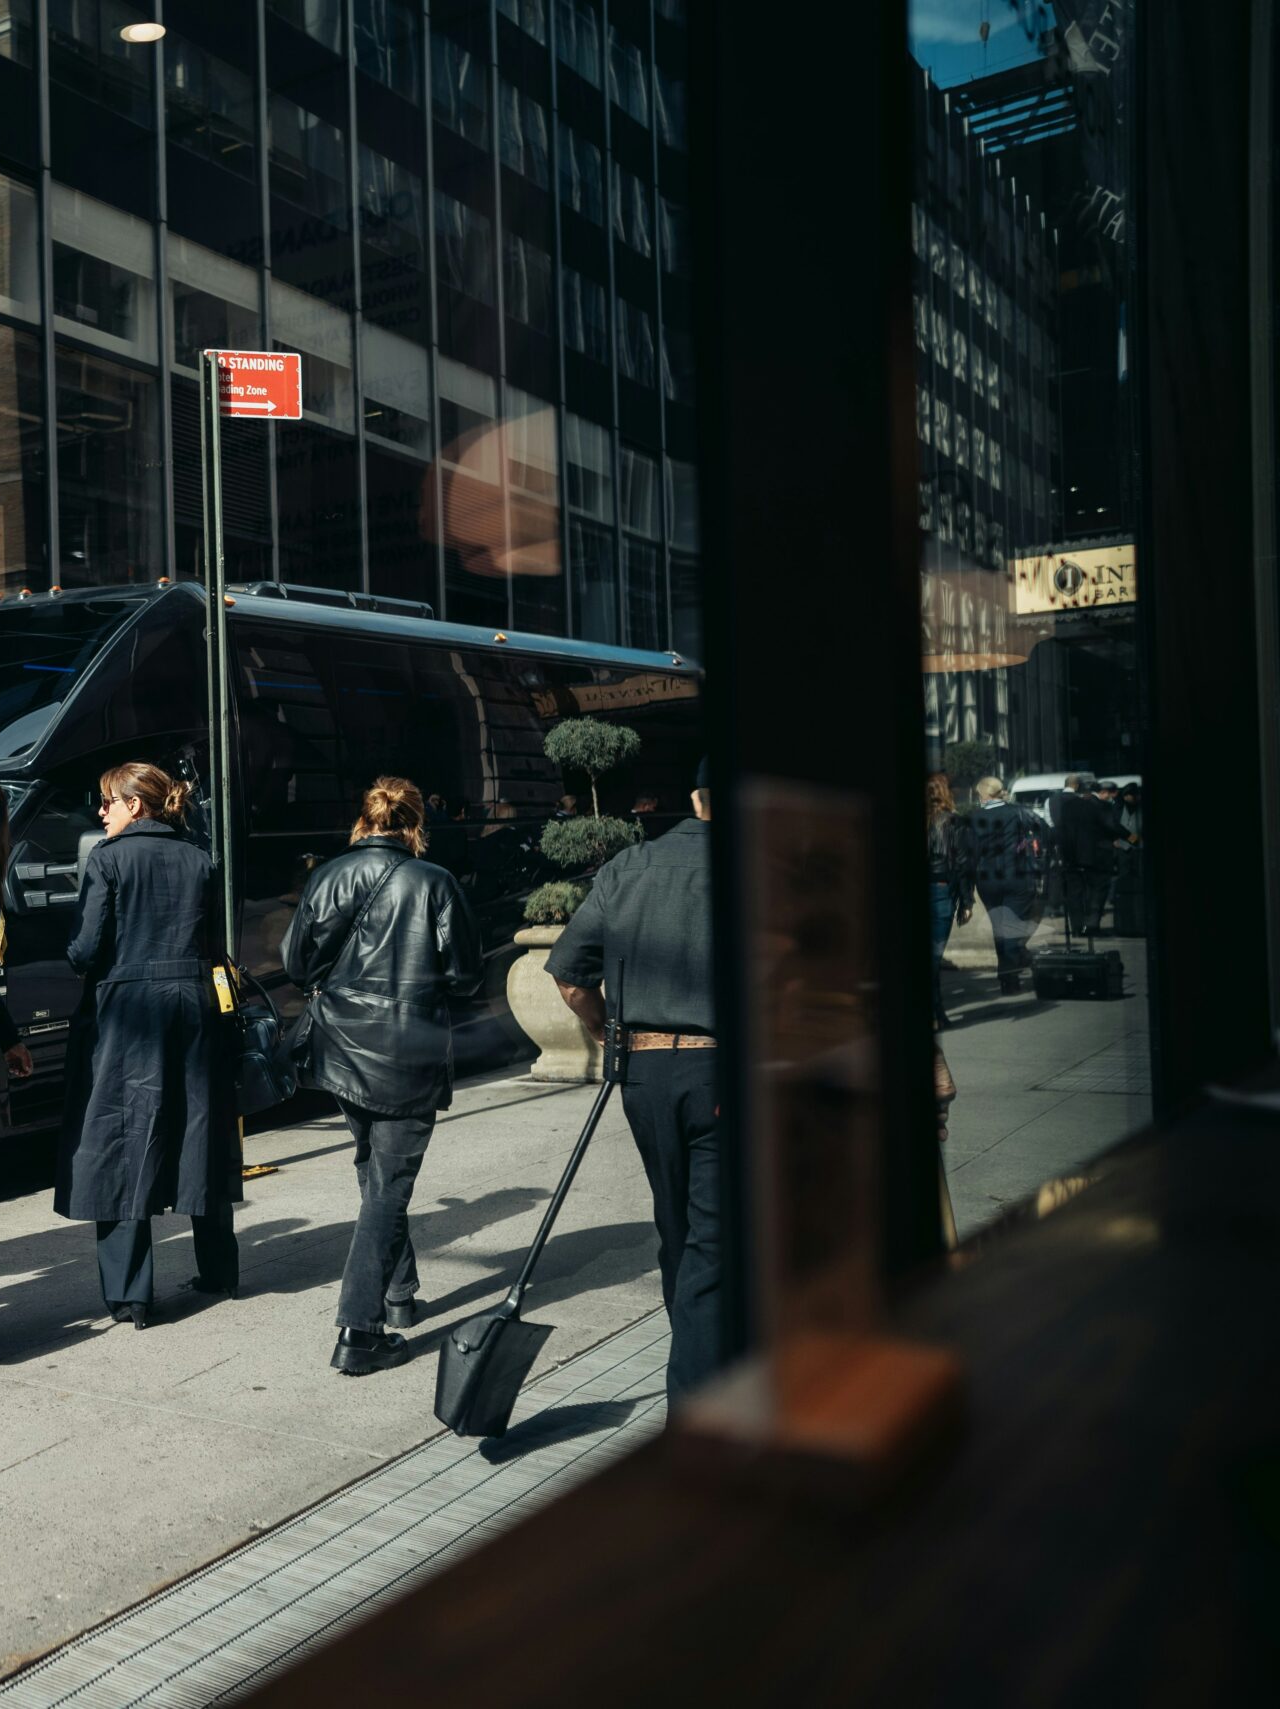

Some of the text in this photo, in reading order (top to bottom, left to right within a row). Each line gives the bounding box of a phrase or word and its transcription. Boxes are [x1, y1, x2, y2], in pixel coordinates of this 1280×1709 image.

[229, 357, 284, 371] STANDING
[220, 385, 268, 396] ading Zone
